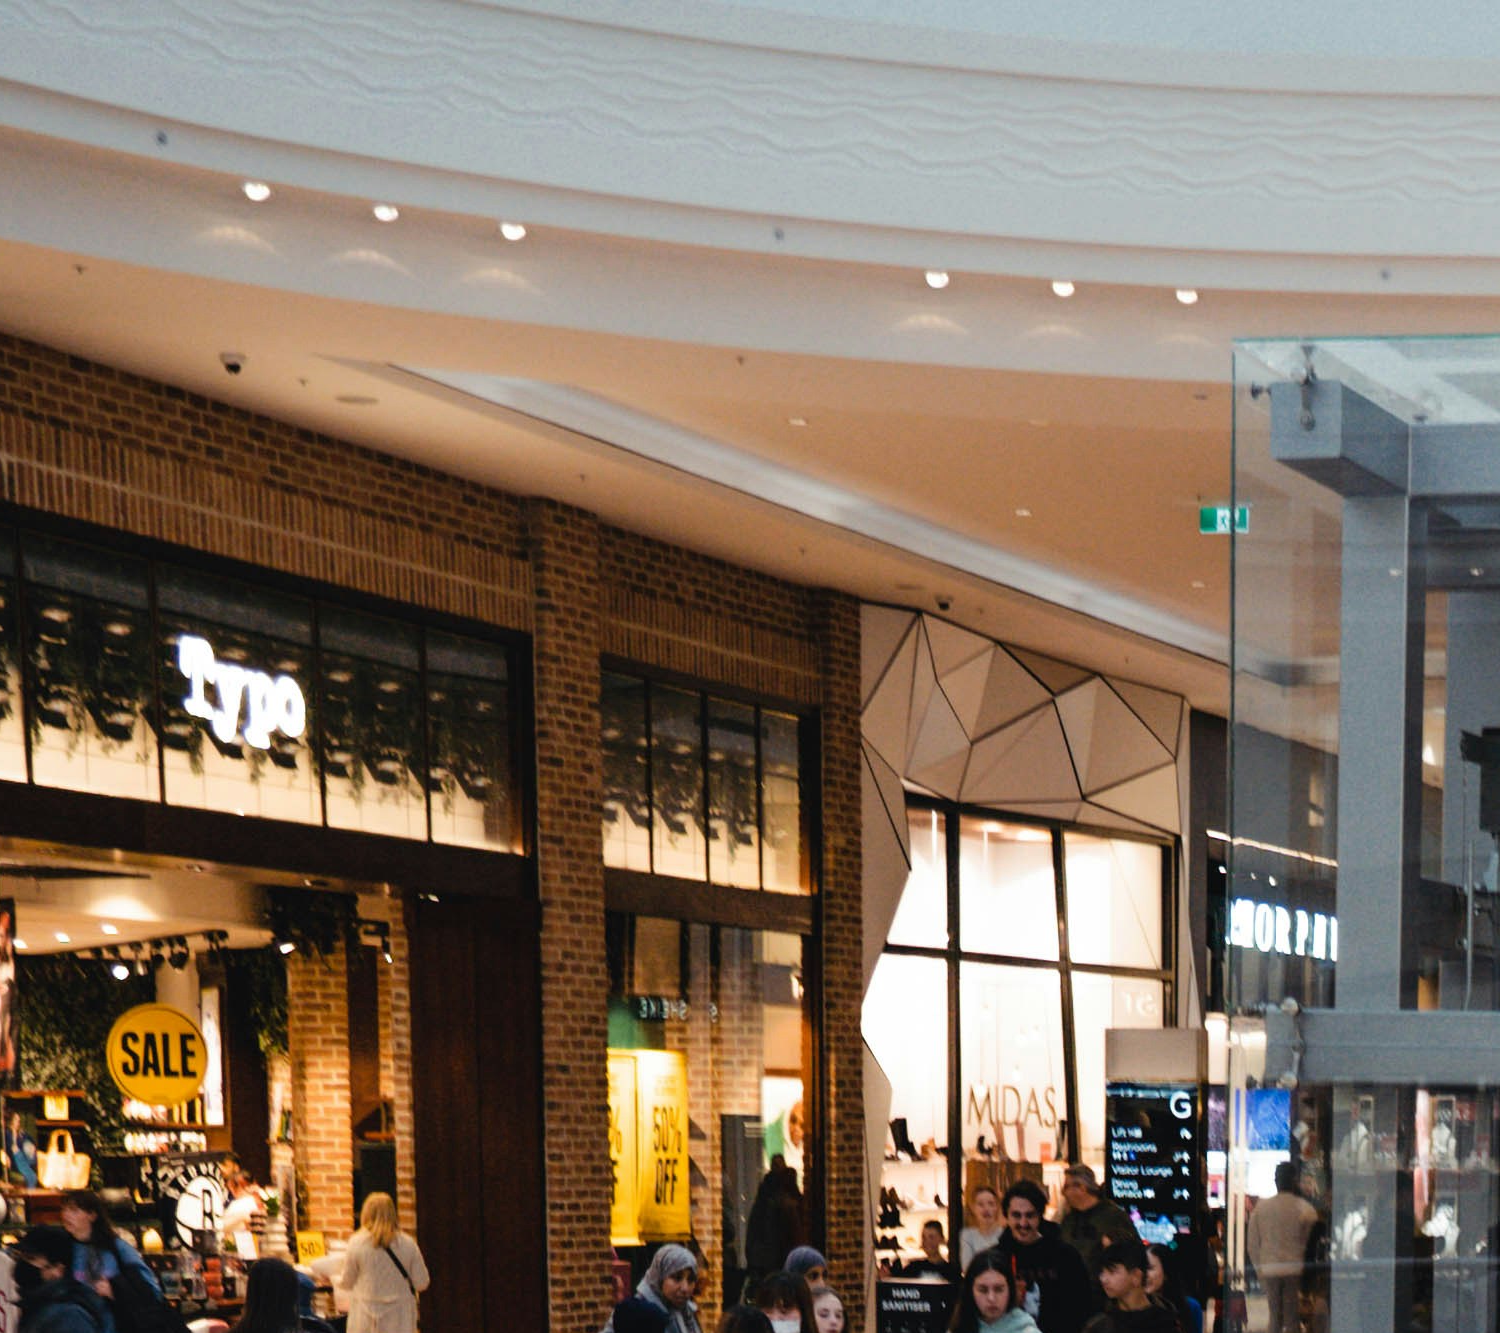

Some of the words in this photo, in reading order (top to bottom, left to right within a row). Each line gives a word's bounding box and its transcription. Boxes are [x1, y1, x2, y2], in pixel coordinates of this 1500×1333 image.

[178, 634, 306, 750] Typo
[120, 1031, 197, 1078] SALE
[967, 1084, 1057, 1128] MIDAS
[1169, 1090, 1192, 1119] G
[653, 1106, 682, 1153] 50%
[655, 1158, 678, 1205] OFF
[881, 1301, 932, 1313] SANITISER
[891, 1287, 921, 1300] HAND
